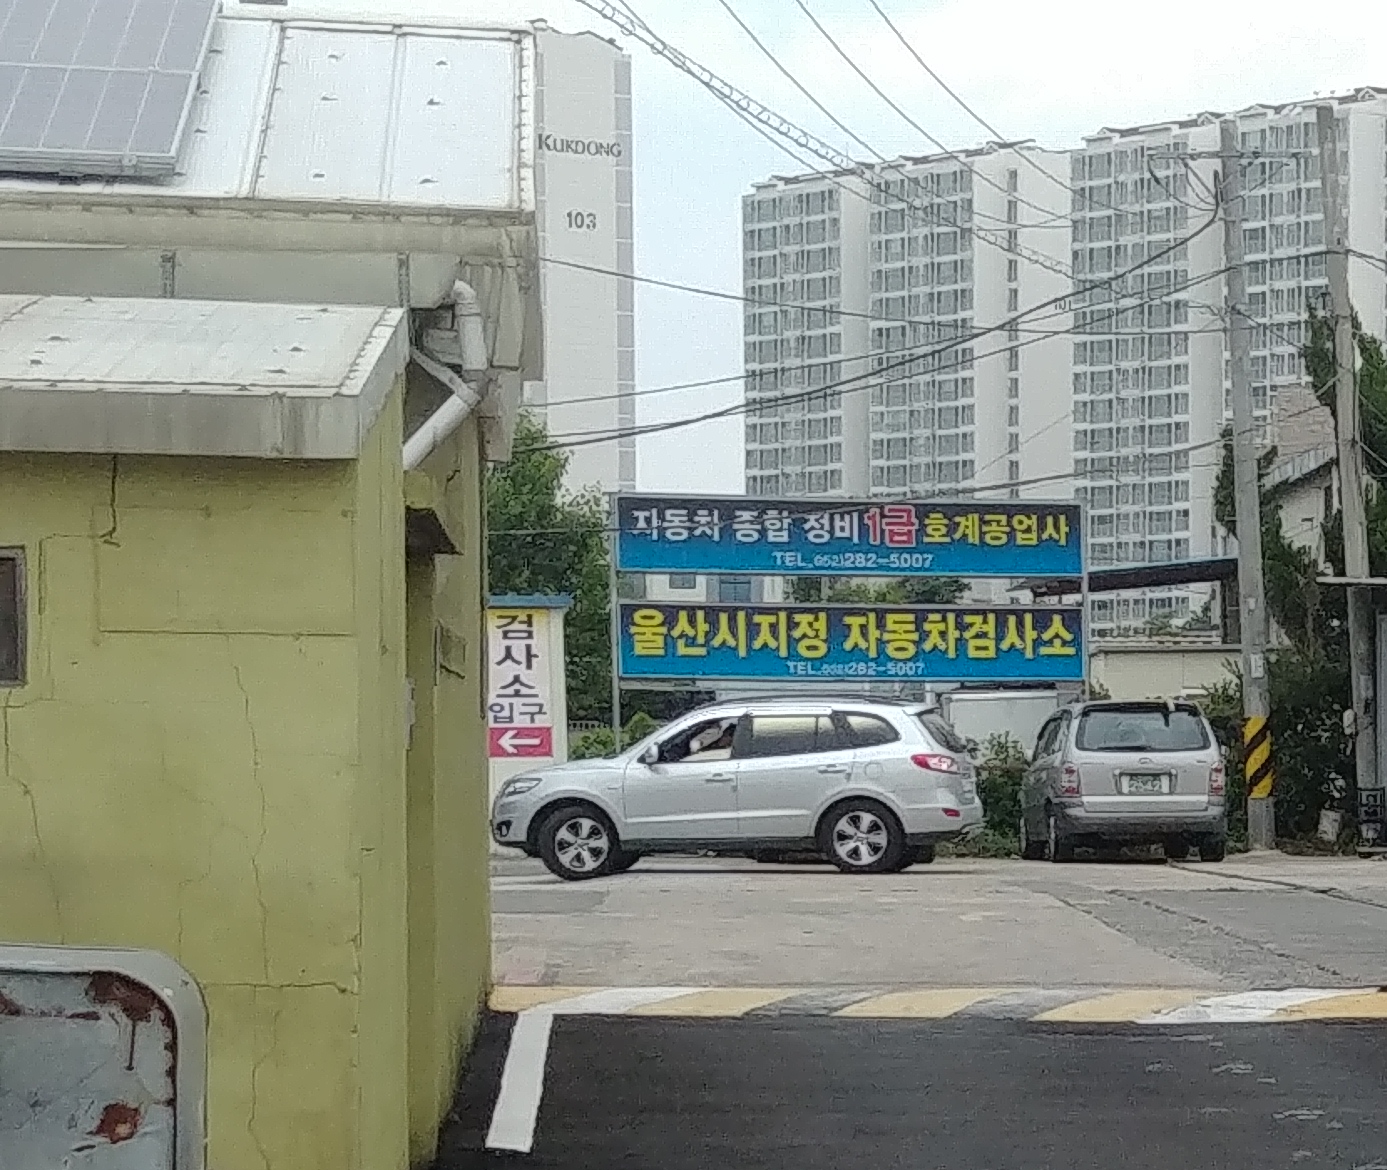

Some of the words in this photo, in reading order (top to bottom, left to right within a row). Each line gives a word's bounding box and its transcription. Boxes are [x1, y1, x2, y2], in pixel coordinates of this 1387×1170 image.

[537, 133, 622, 158] KUKDONG
[566, 211, 597, 230] 103
[625, 507, 721, 542] 자동차
[732, 508, 793, 543] 종합
[803, 510, 860, 544] 정비
[863, 504, 919, 548] 1급
[922, 510, 1070, 546] 호계공업사
[629, 607, 828, 659] 울산시지정
[842, 611, 1077, 660] 자동차검사소
[494, 613, 540, 698] 검사소
[488, 702, 548, 724] 입구
